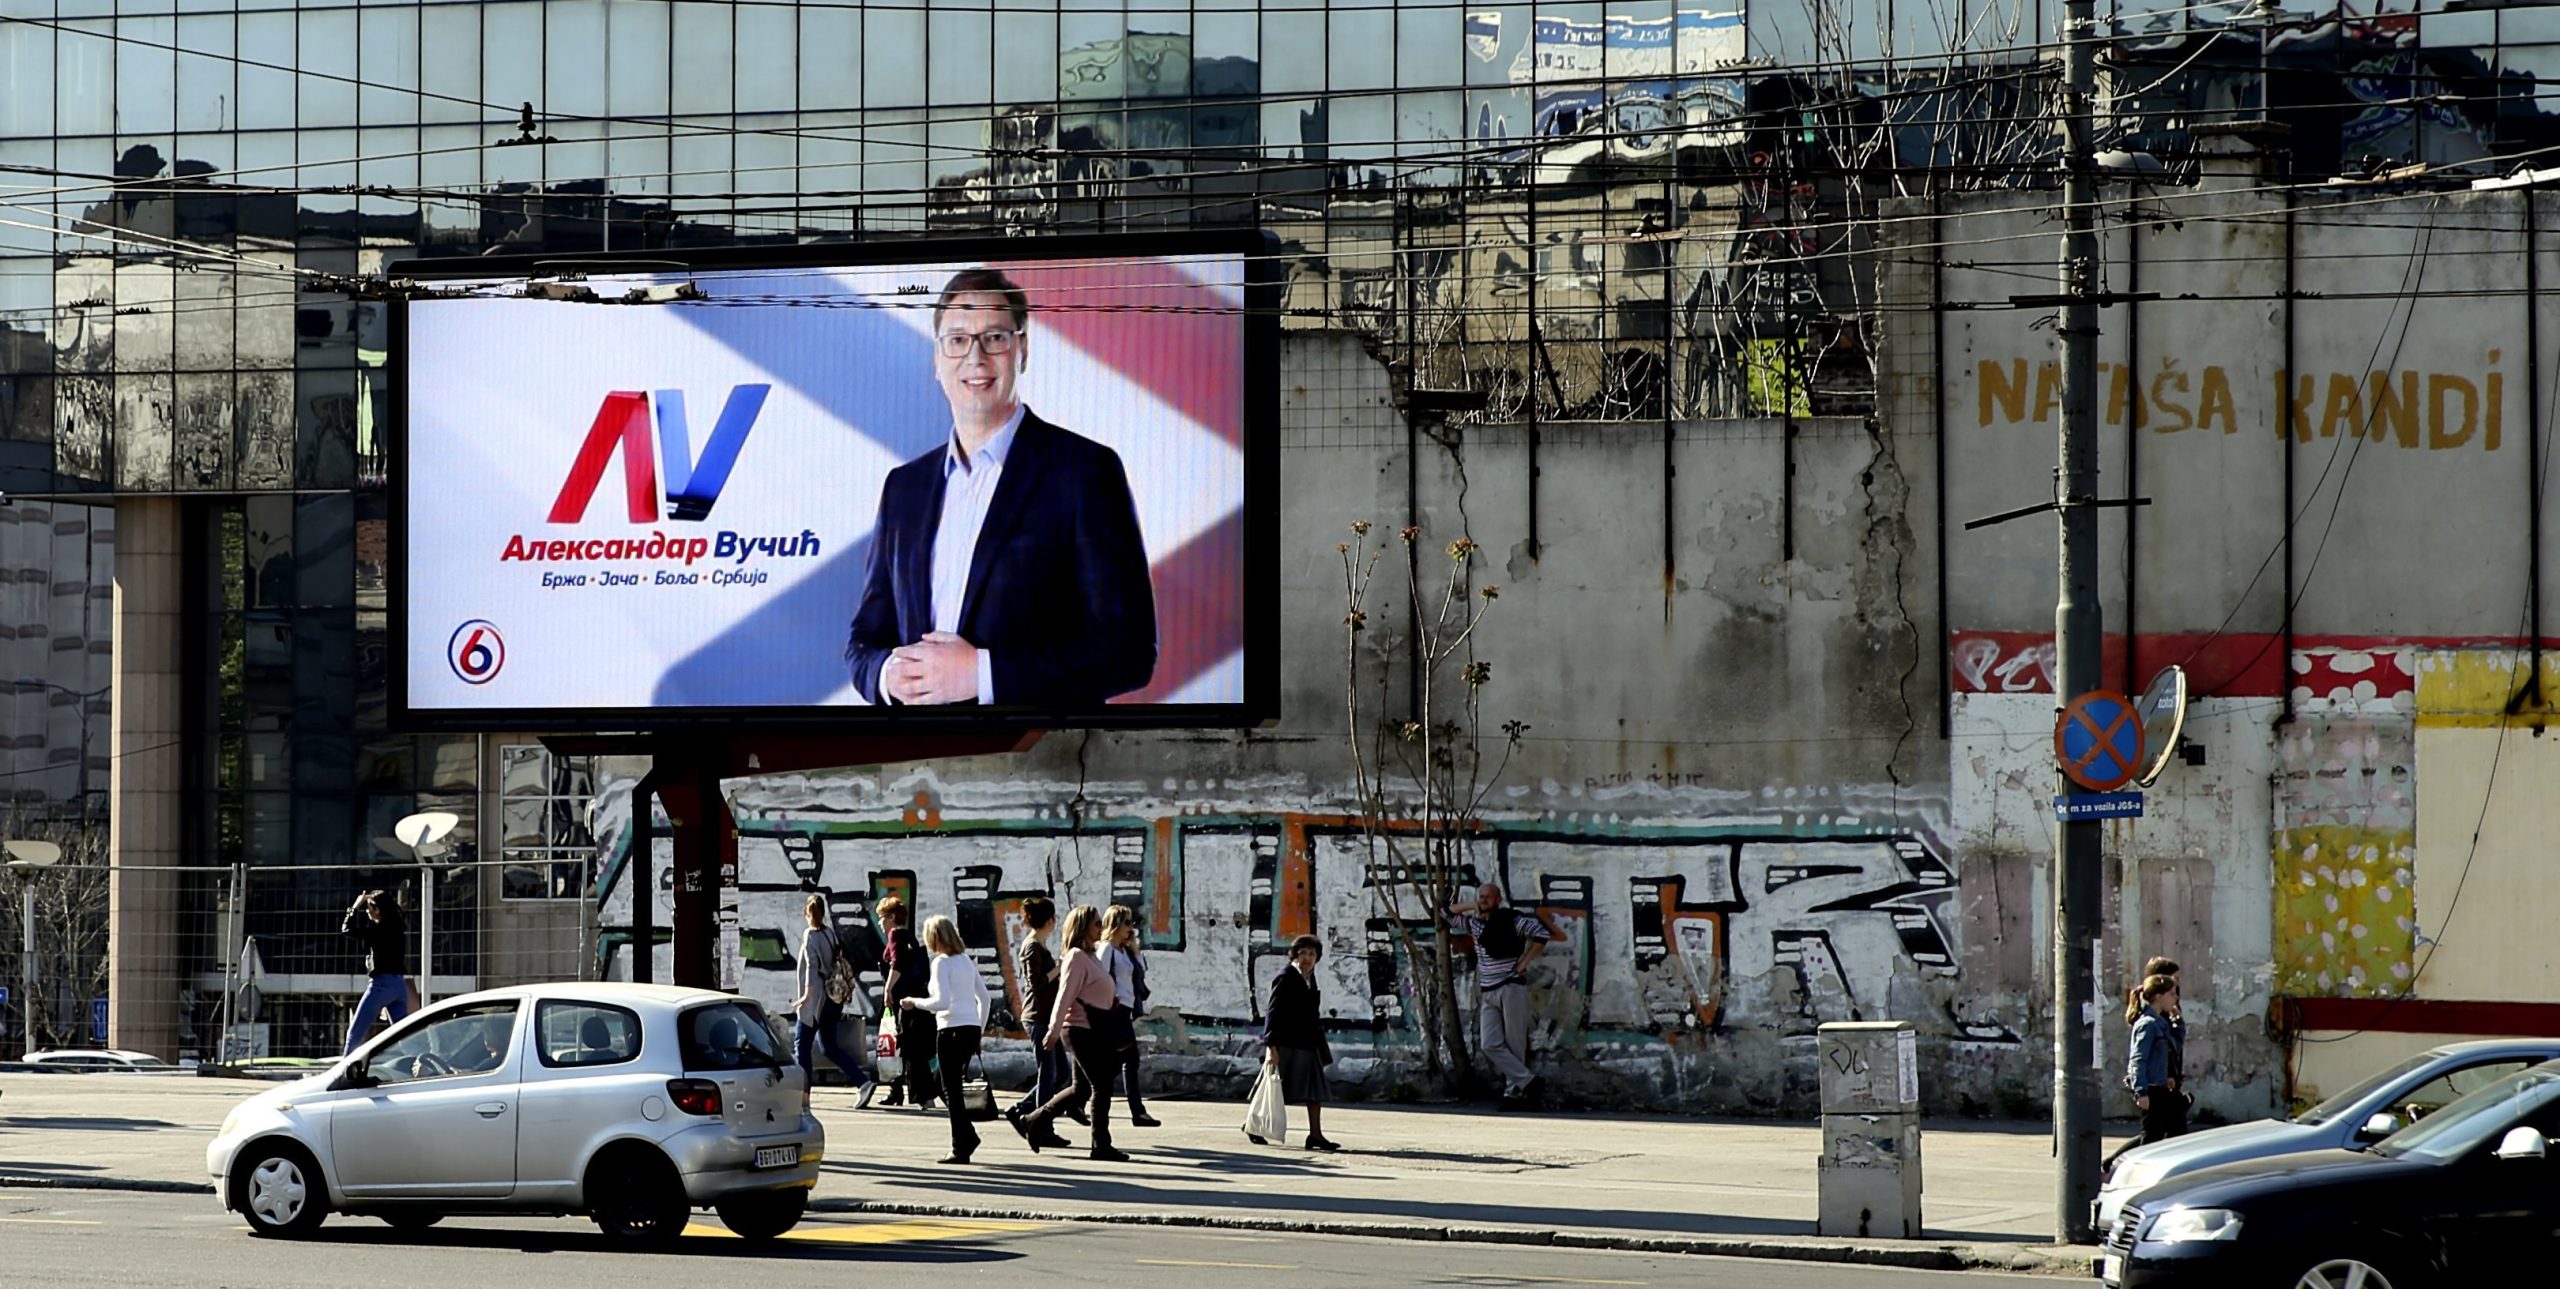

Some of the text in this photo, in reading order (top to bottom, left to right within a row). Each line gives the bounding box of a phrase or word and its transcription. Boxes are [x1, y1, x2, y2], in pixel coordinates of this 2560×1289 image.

[1978, 356, 2237, 434] NAAŠA
[501, 530, 820, 565] Александар Вучић
[542, 569, 768, 590] Бржа Јача Боља Србија
[460, 629, 492, 675] 6
[2081, 804, 2092, 813] za
[2094, 801, 2116, 812] vozila
